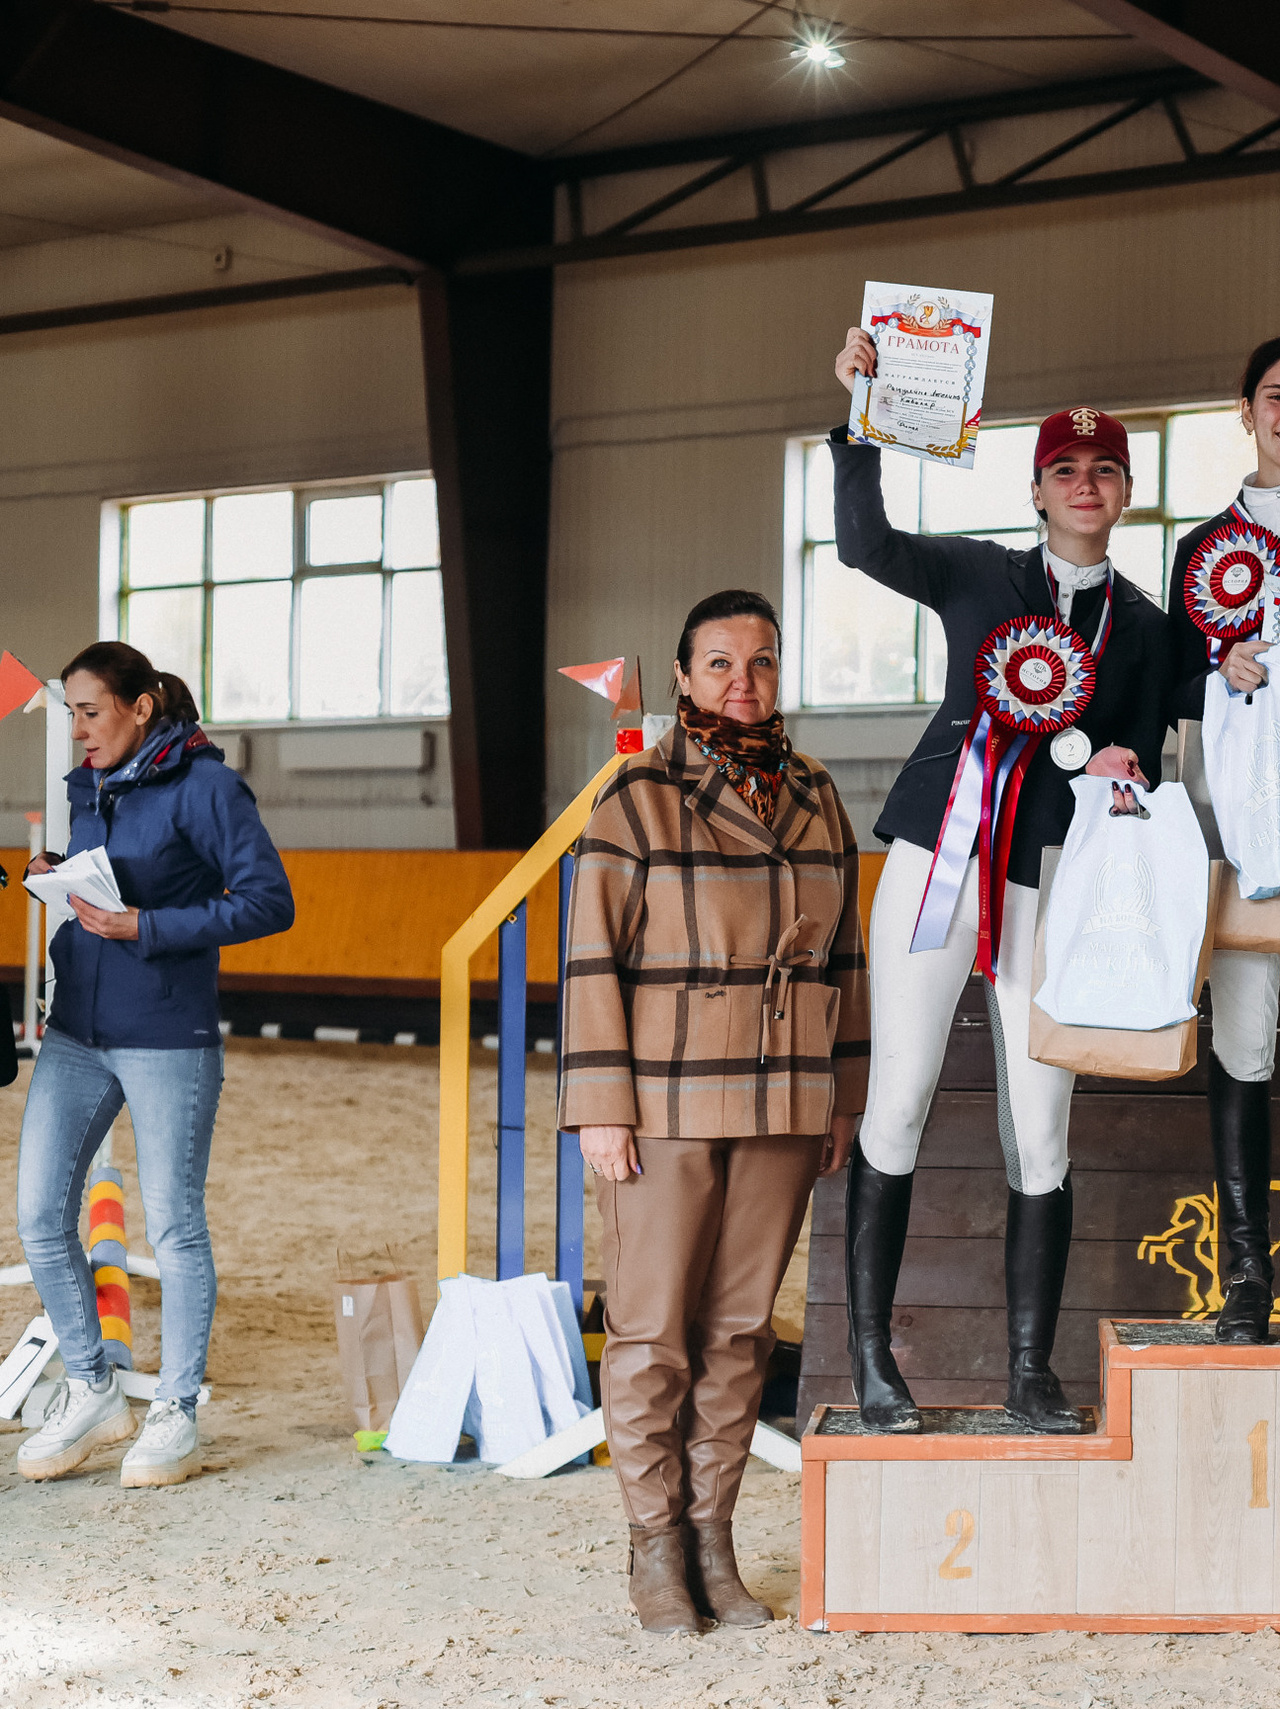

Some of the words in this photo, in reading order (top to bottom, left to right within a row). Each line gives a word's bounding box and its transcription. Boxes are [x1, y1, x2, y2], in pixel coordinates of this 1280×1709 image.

[888, 336, 959, 354] ГРАМОТА
[885, 373, 955, 385] НАГРАЖДАЕТСЯ
[1260, 786, 1271, 799] НА
[1247, 1420, 1270, 1509] 1
[938, 1508, 975, 1580] 2
